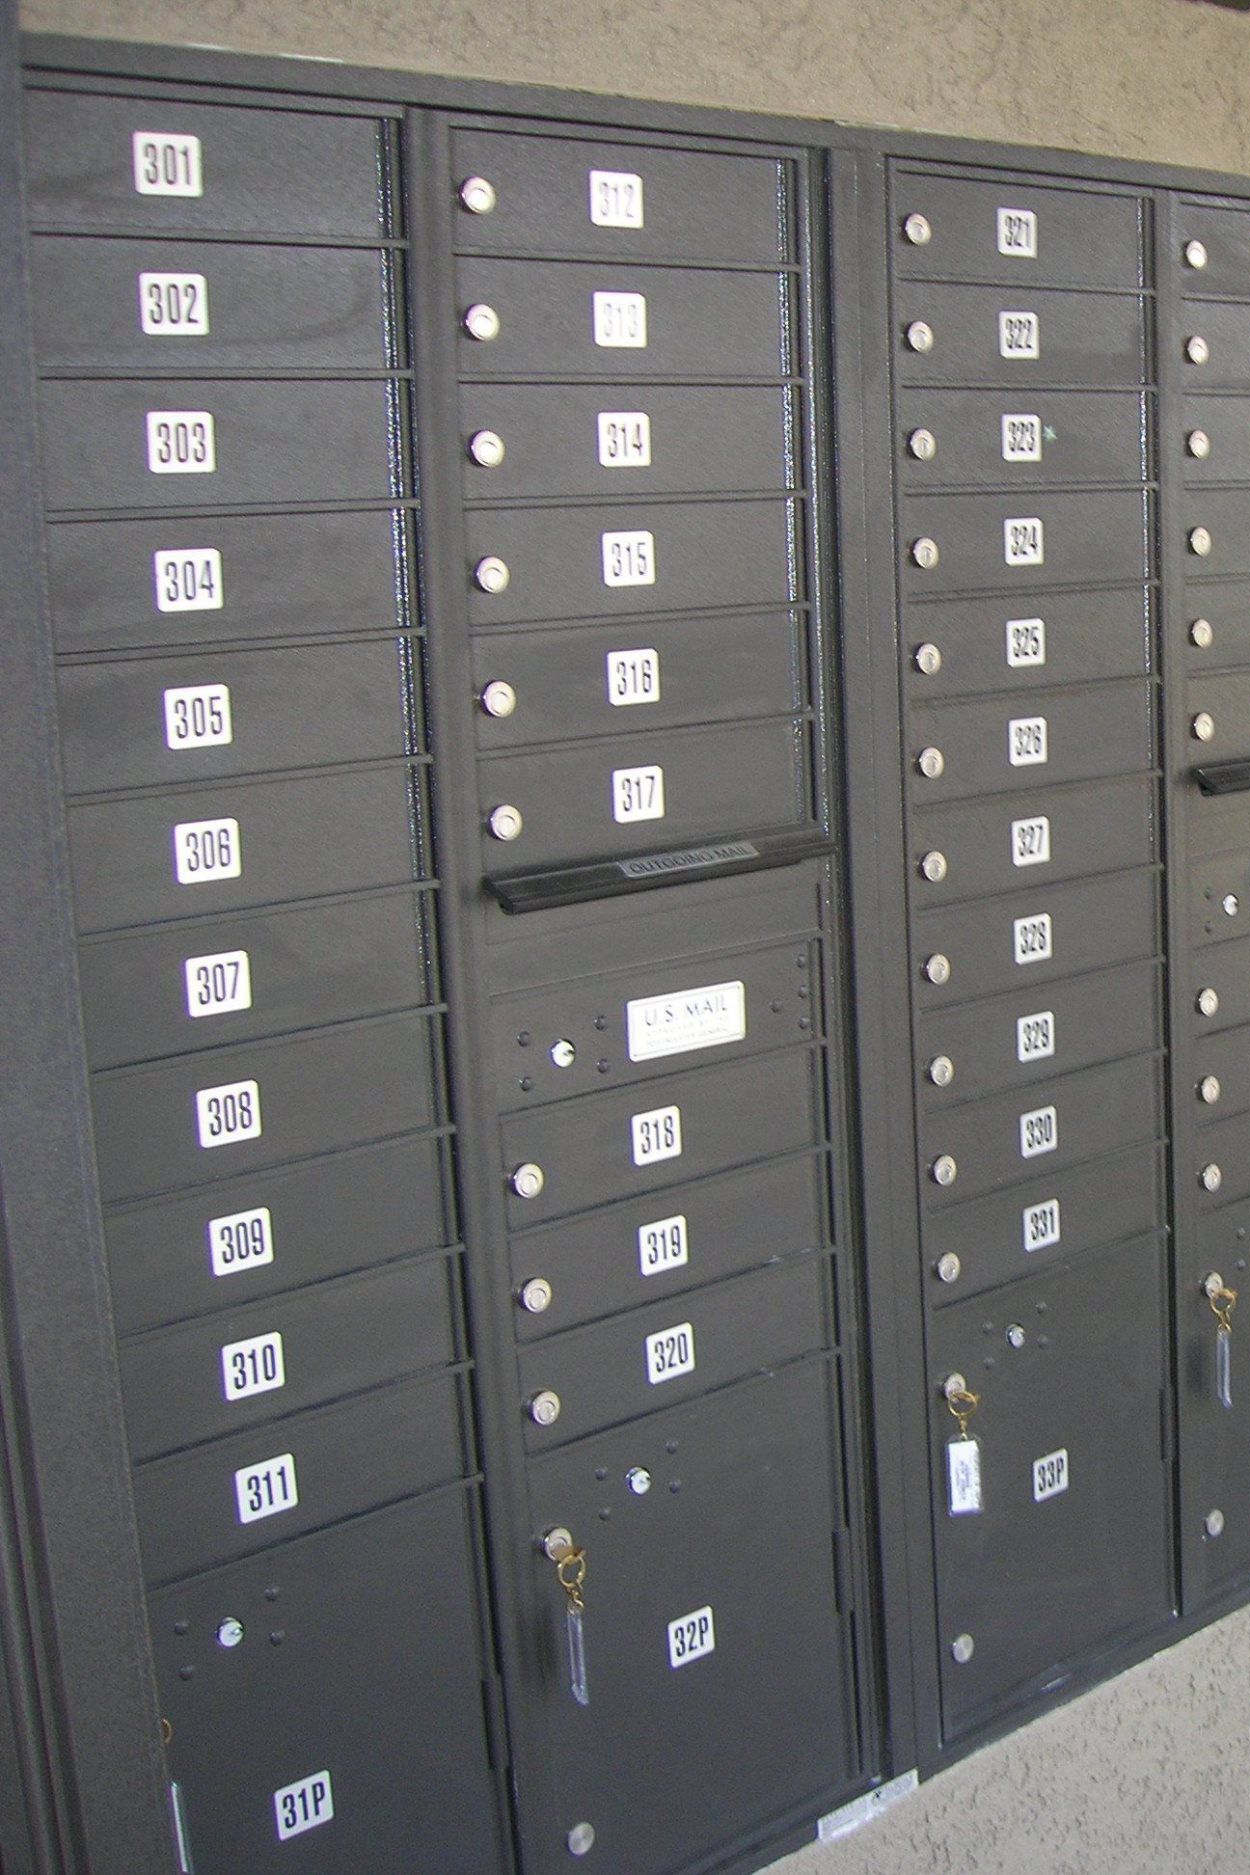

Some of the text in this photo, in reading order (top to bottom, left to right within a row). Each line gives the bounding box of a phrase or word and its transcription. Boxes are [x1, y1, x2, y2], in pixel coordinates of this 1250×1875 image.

[144, 143, 190, 185] 301
[599, 182, 633, 218] 312
[1005, 215, 1030, 247] 321
[149, 283, 198, 324] 302
[1006, 319, 1032, 349] 322
[158, 423, 205, 463] 303
[608, 423, 643, 458] 314
[1009, 422, 1035, 452] 323
[1011, 526, 1038, 556] 324
[612, 542, 646, 577] 315
[165, 560, 213, 602] 304
[1013, 627, 1039, 658] 325
[617, 660, 651, 695] 316
[175, 696, 222, 739] 305
[1016, 725, 1041, 756] 326
[622, 775, 654, 812] 317
[186, 829, 230, 872] 306
[628, 845, 749, 873] OUTGOING MAIL
[1019, 825, 1043, 857] 327
[1021, 922, 1046, 954] 328
[197, 961, 239, 1005] 307
[685, 994, 728, 1016] MAIL
[1024, 1020, 1049, 1052] 329
[208, 1091, 252, 1136] 308
[1027, 1115, 1052, 1148] 330
[641, 1116, 674, 1154] 318
[220, 1219, 264, 1263] 309
[1031, 1208, 1054, 1241] 331
[648, 1226, 681, 1264] 319
[233, 1344, 275, 1389] 310
[655, 1333, 688, 1372] 320
[247, 1466, 287, 1511] 311
[1039, 1457, 1064, 1492] 33P
[674, 1617, 708, 1657] 32P
[283, 1782, 325, 1828] 31P
